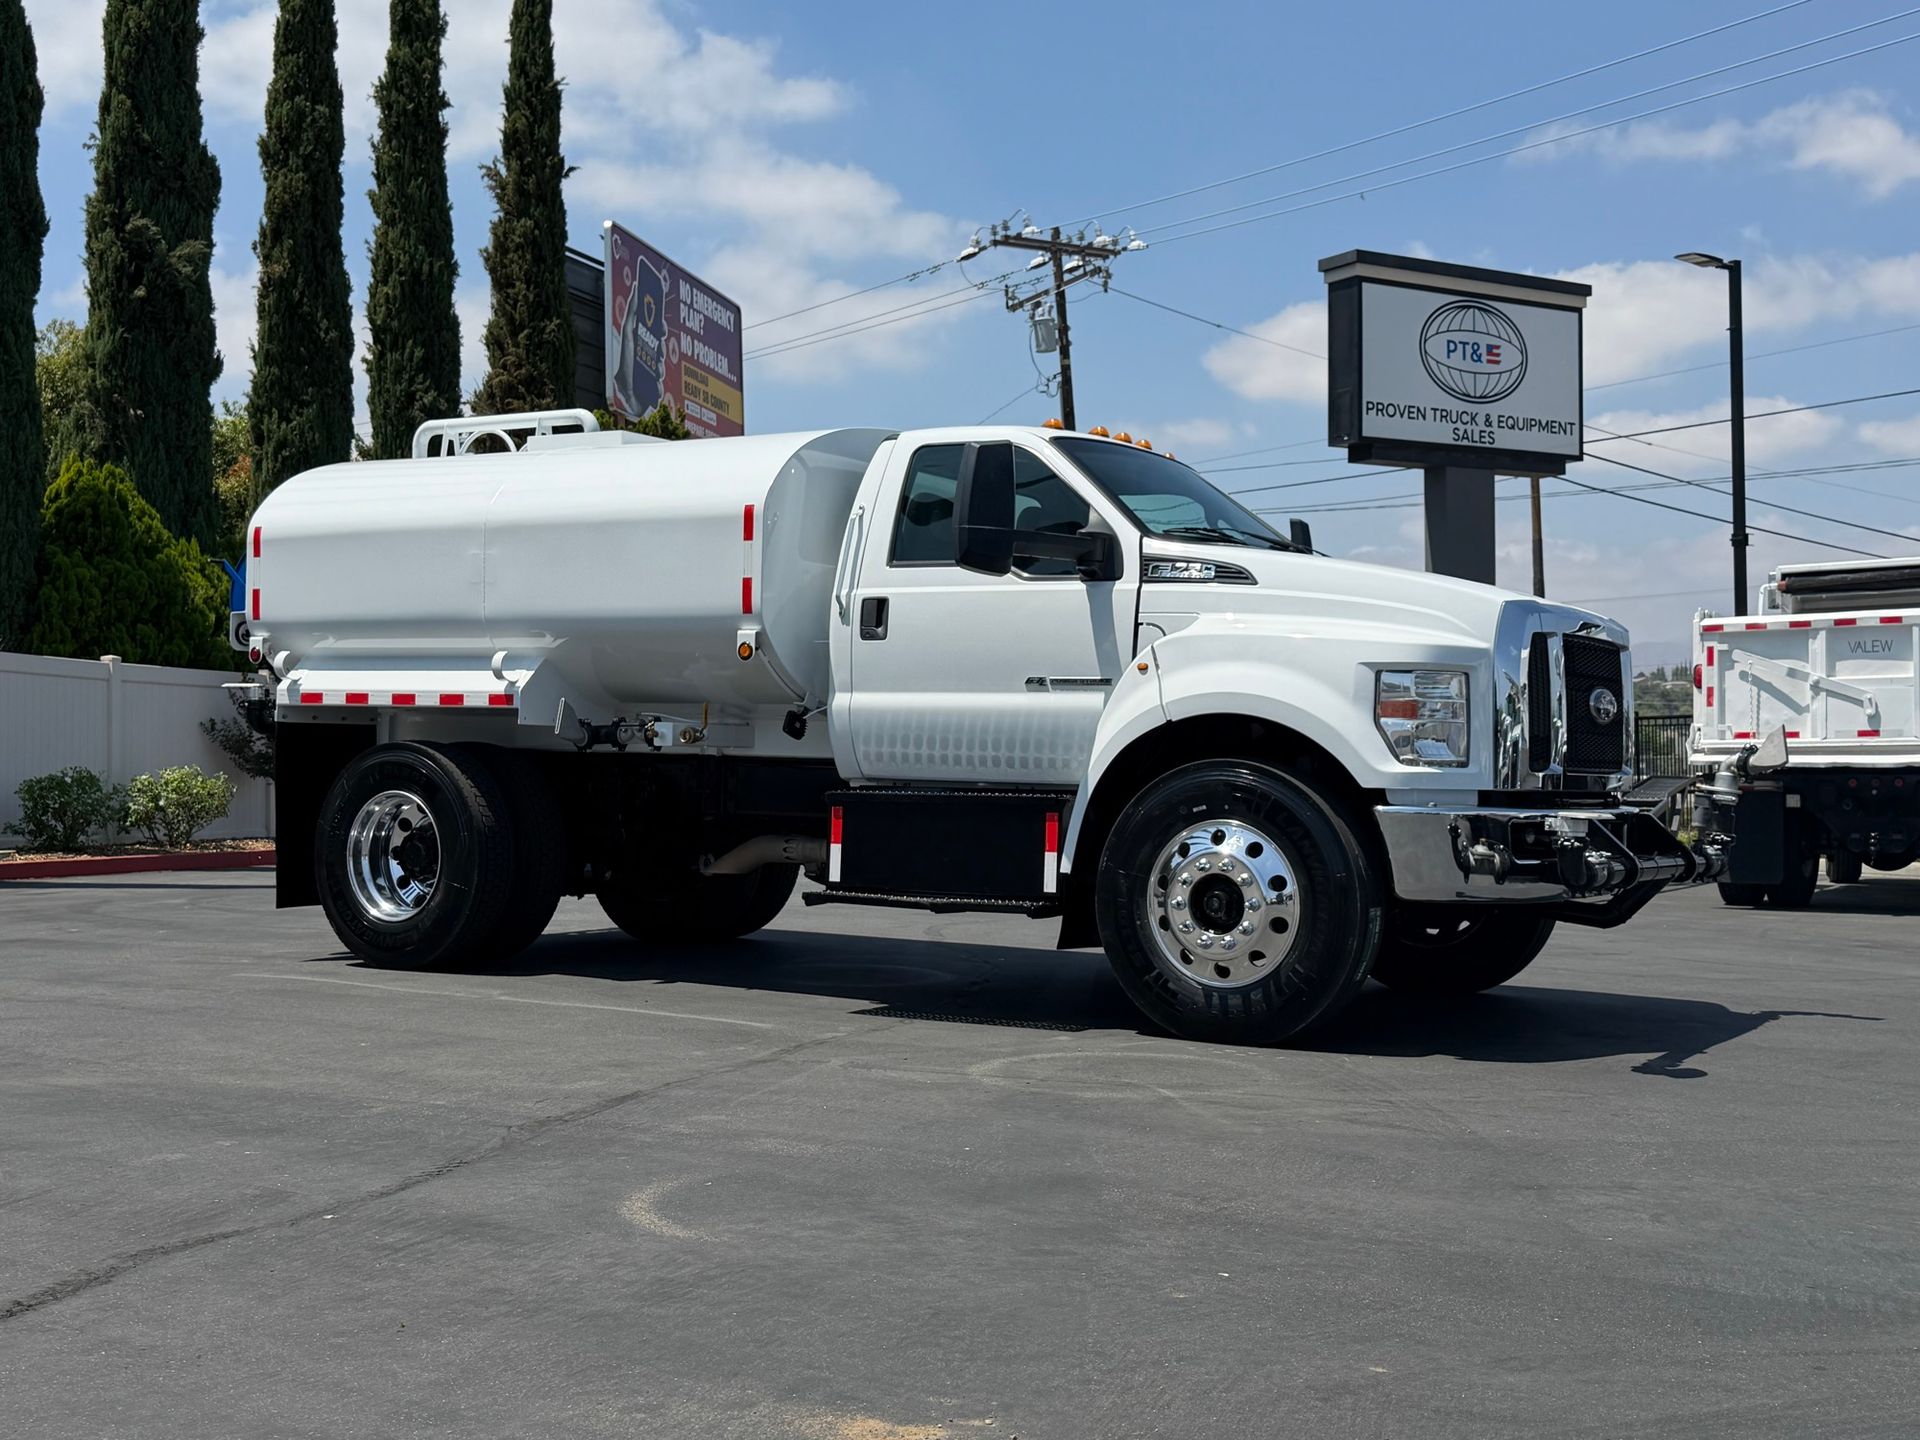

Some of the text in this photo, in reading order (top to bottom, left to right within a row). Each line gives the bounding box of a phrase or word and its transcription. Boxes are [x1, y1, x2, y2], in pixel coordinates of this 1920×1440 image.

[679, 278, 736, 332] NO EMERGENCY
[680, 302, 705, 336] PLAN?
[638, 322, 660, 352] READY
[680, 331, 693, 357] NO
[1446, 339, 1502, 366] PT&E
[684, 380, 702, 402] READY
[710, 393, 730, 416] COUNTY
[1365, 401, 1576, 436] PROVEN TRUCK & EQUIPMENT
[1452, 427, 1496, 445] SALES
[1848, 639, 1894, 653] VALEW
